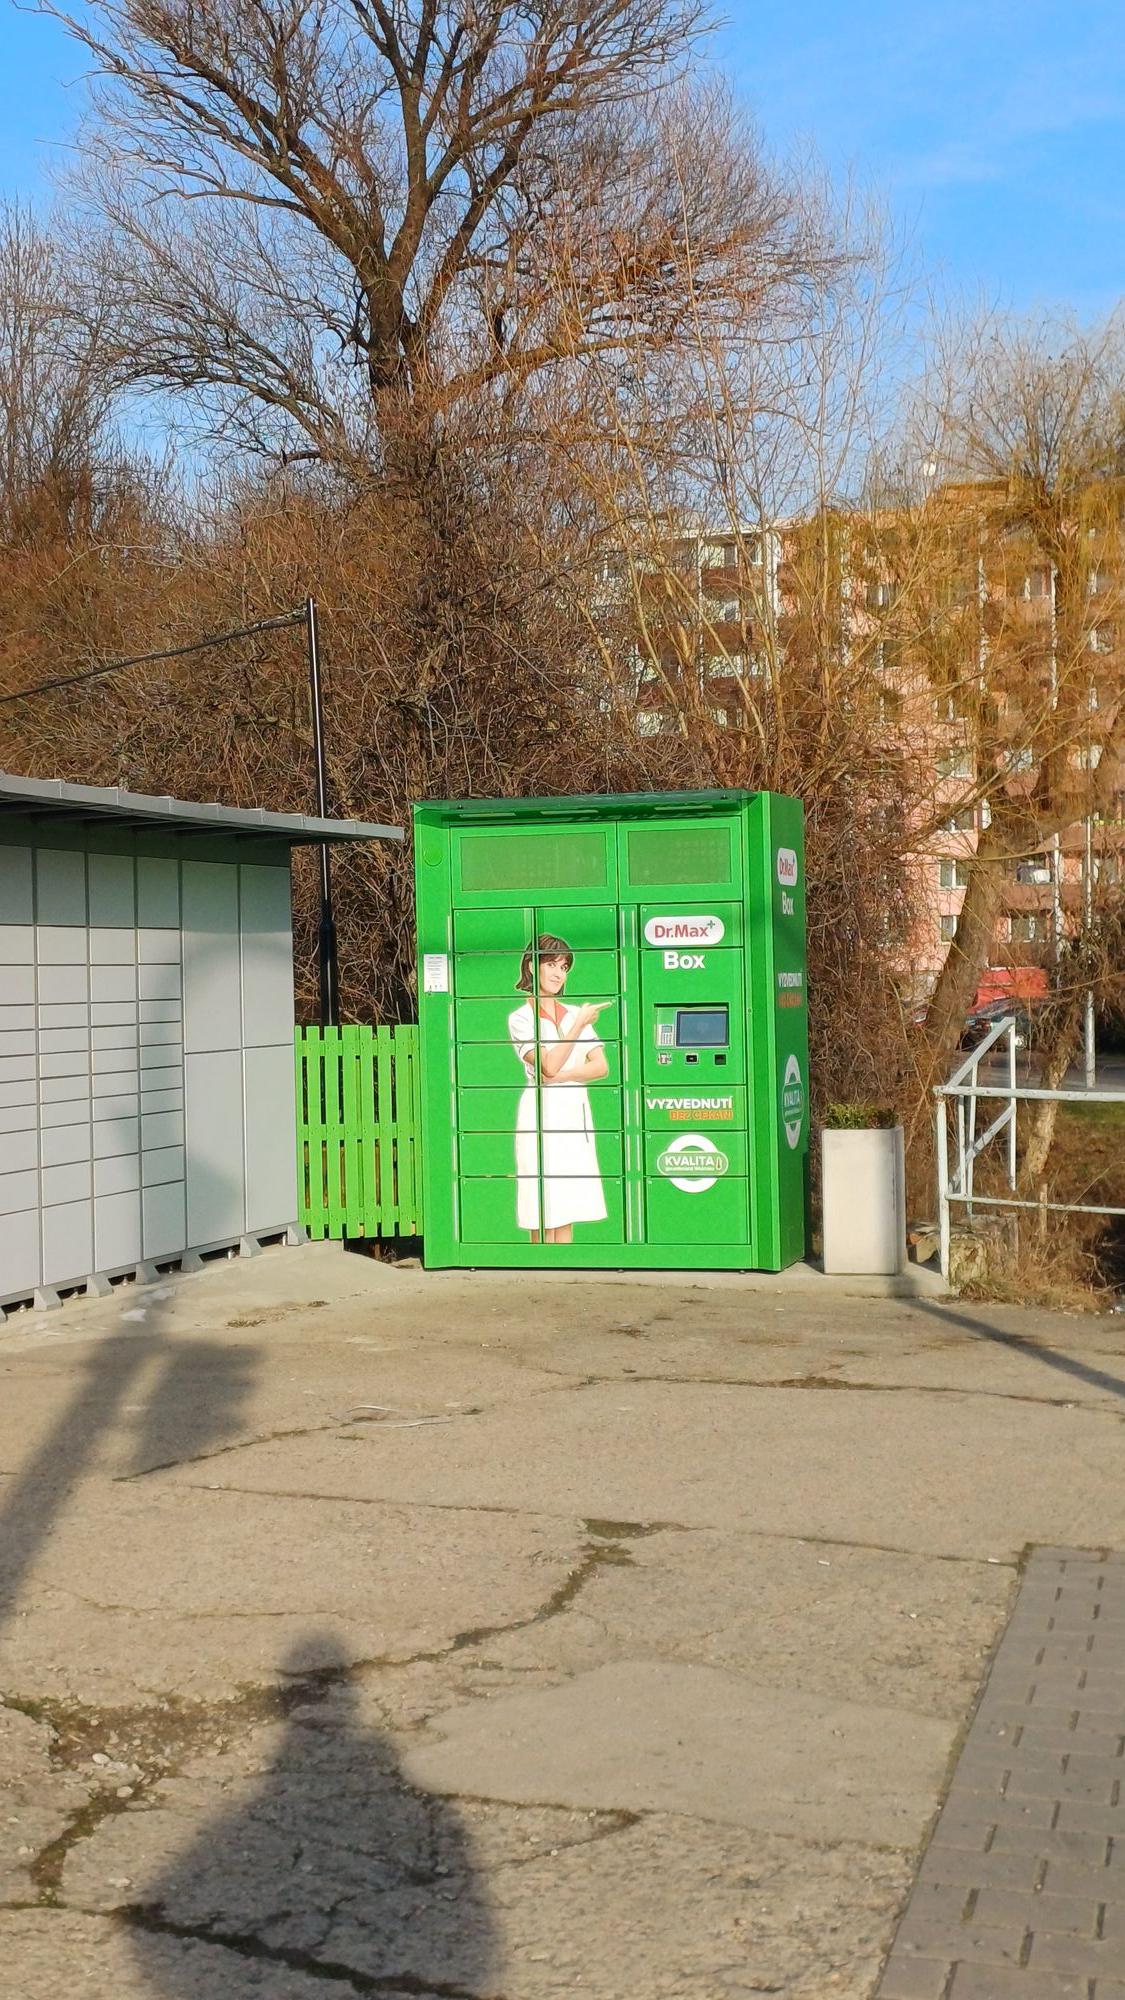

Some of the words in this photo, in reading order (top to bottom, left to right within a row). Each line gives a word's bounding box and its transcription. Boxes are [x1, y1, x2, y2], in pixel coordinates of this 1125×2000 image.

[781, 891, 794, 916] Box
[664, 951, 706, 970] Box
[646, 1096, 733, 1110] VYZVEDNUTÍ
[664, 1155, 715, 1167] KVALITA
